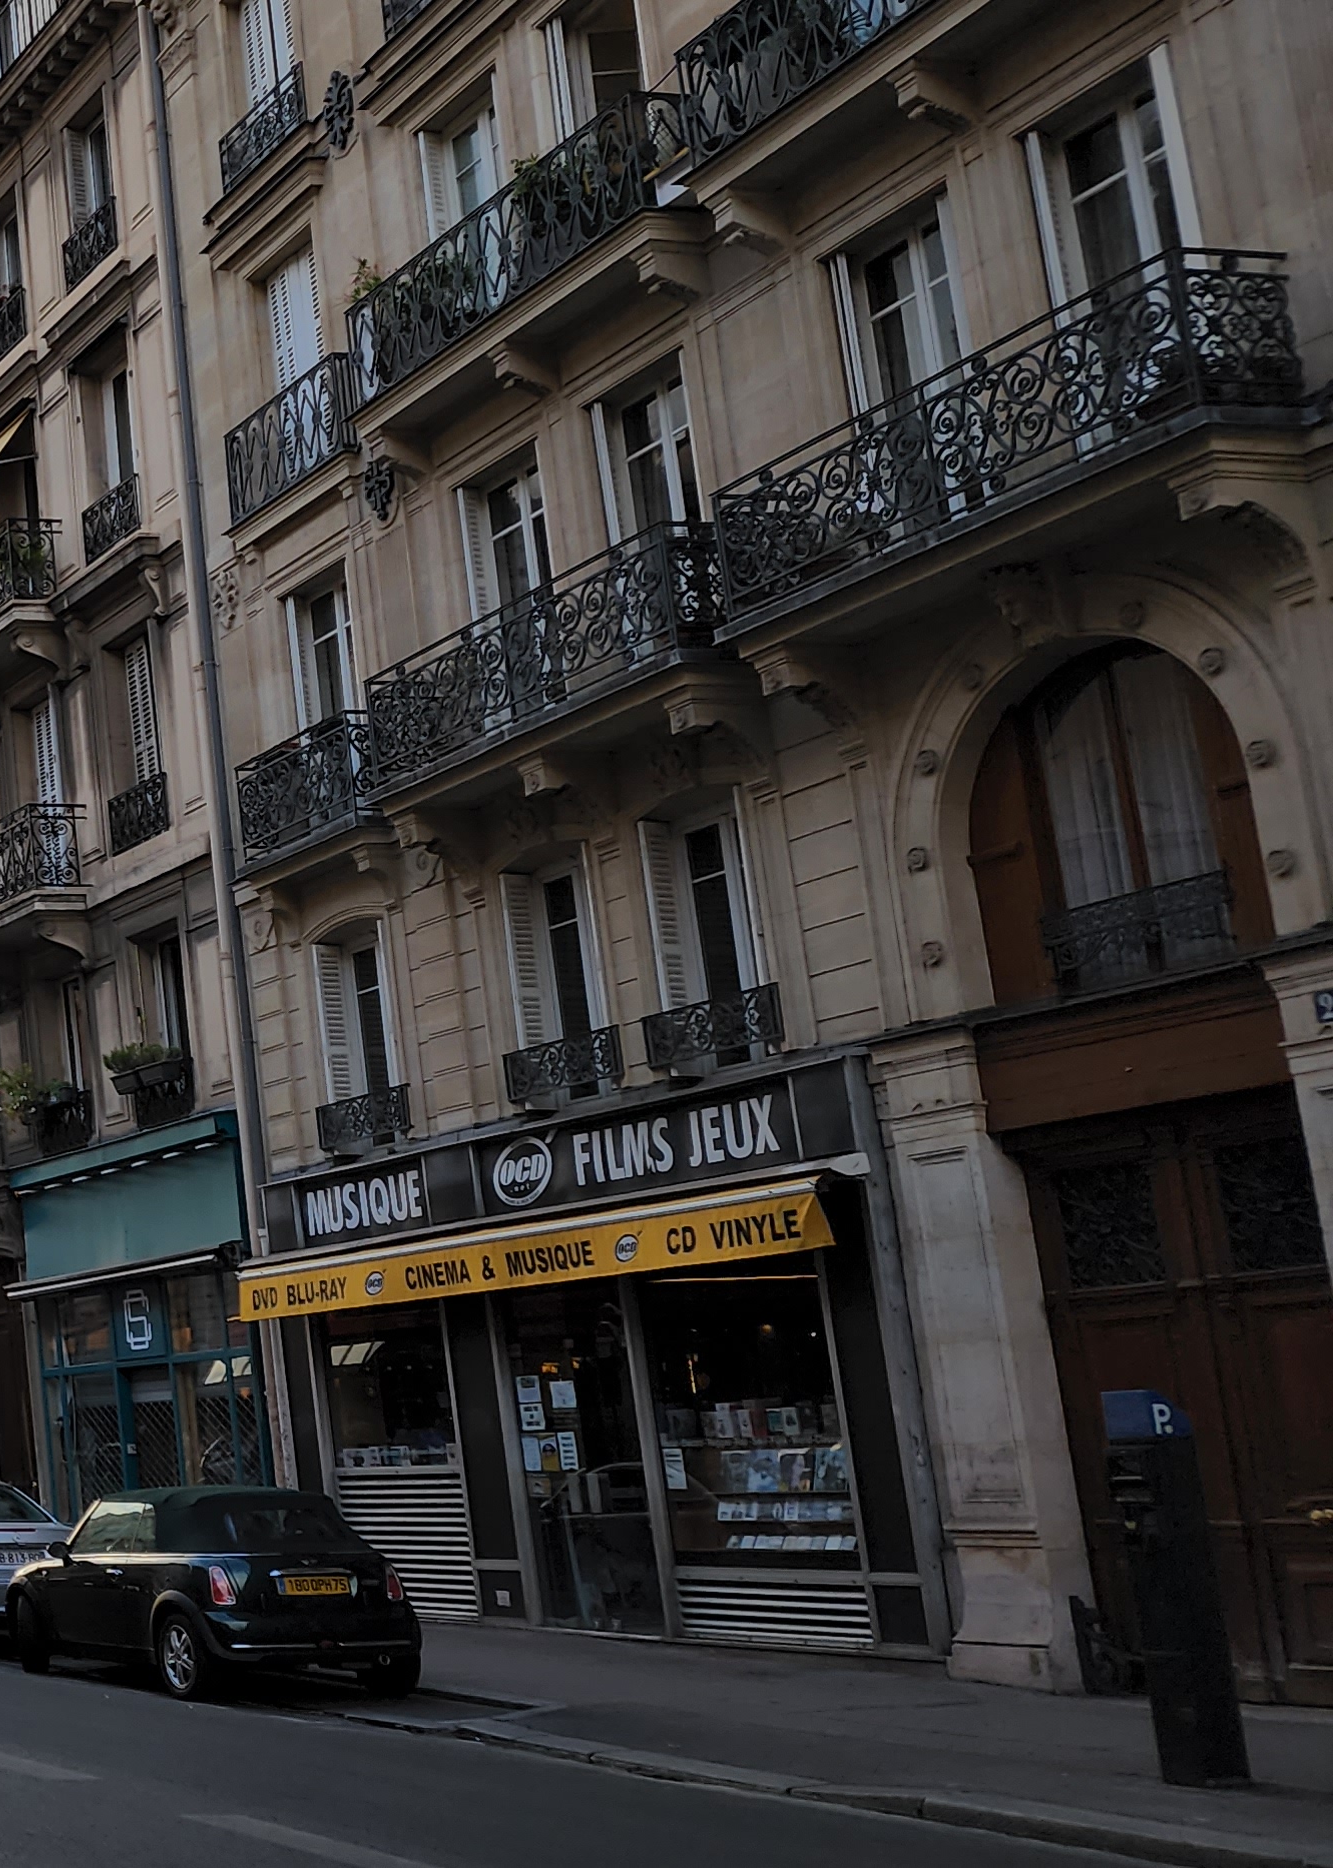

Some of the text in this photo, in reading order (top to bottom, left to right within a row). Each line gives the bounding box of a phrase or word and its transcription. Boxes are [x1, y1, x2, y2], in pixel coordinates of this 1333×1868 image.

[500, 1154, 546, 1186] OCD
[573, 1094, 781, 1186] FILMS JEUX
[306, 1170, 423, 1236] MUSIQUE
[252, 1287, 278, 1311] DVD
[286, 1276, 347, 1306] BLU-RAY
[405, 1259, 471, 1290] CINEMA
[482, 1255, 496, 1281] &
[505, 1240, 595, 1278] MUSIQUE
[666, 1227, 696, 1255] CD
[709, 1209, 802, 1250] VINYLE
